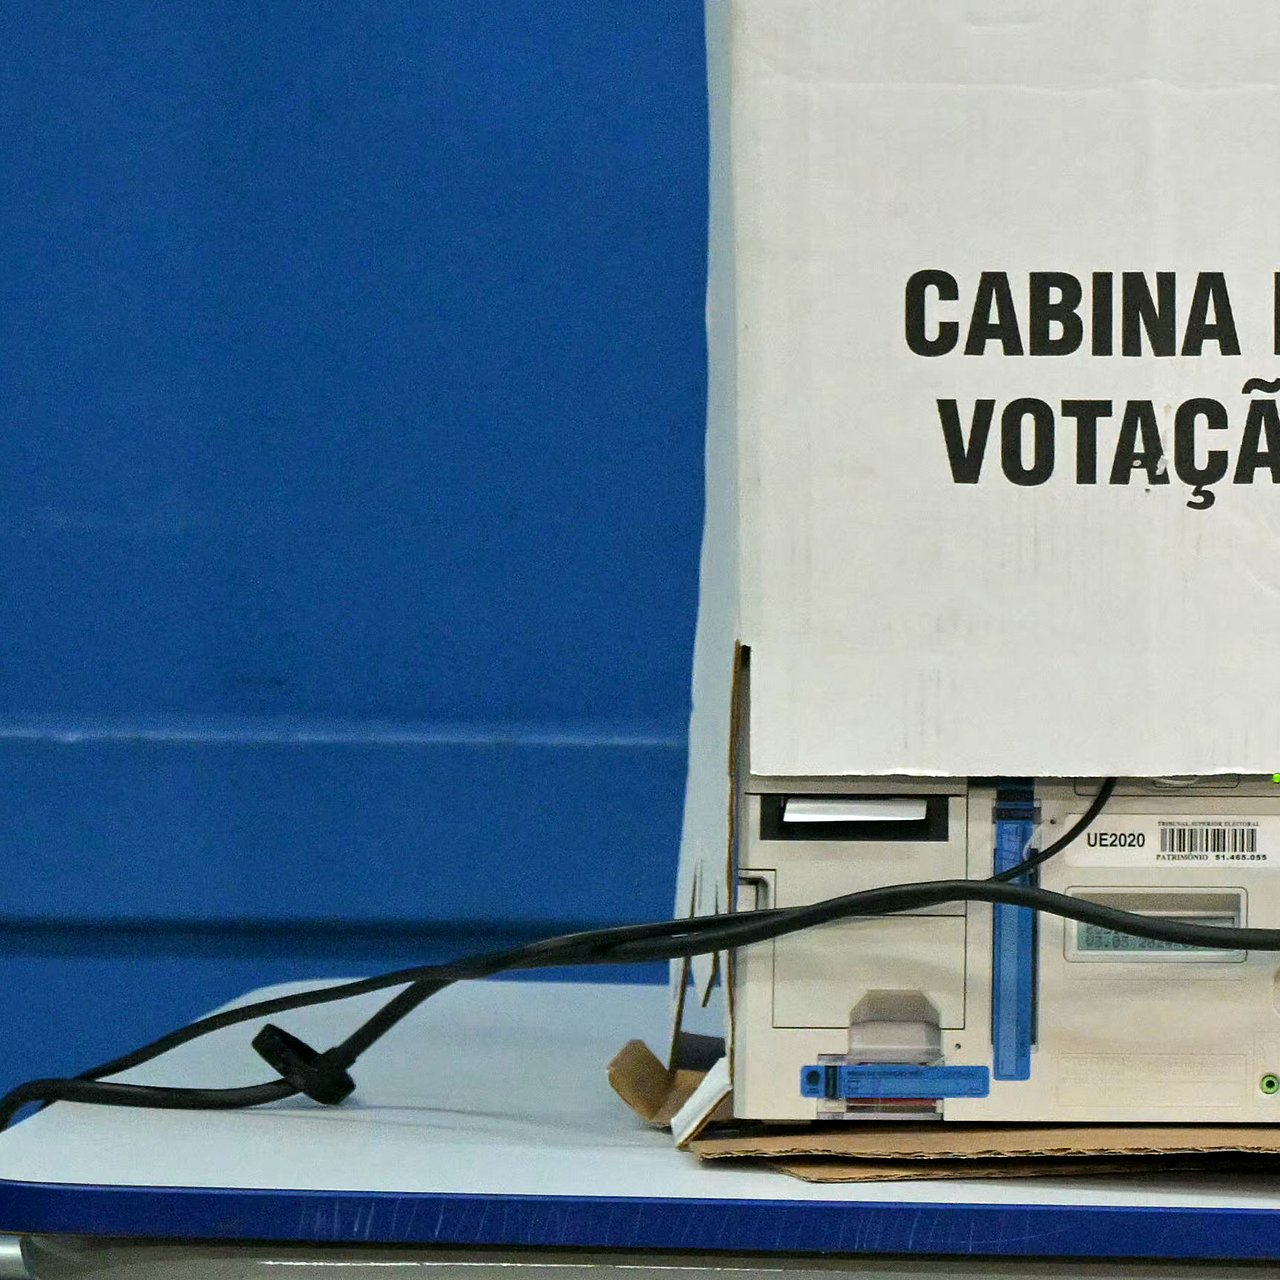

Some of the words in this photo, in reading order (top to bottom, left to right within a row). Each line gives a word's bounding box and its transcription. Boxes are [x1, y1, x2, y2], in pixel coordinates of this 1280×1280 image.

[905, 270, 1242, 356] CABINA
[1087, 832, 1146, 848] UE2020
[1156, 853, 1209, 861] PATRIMÔNIO
